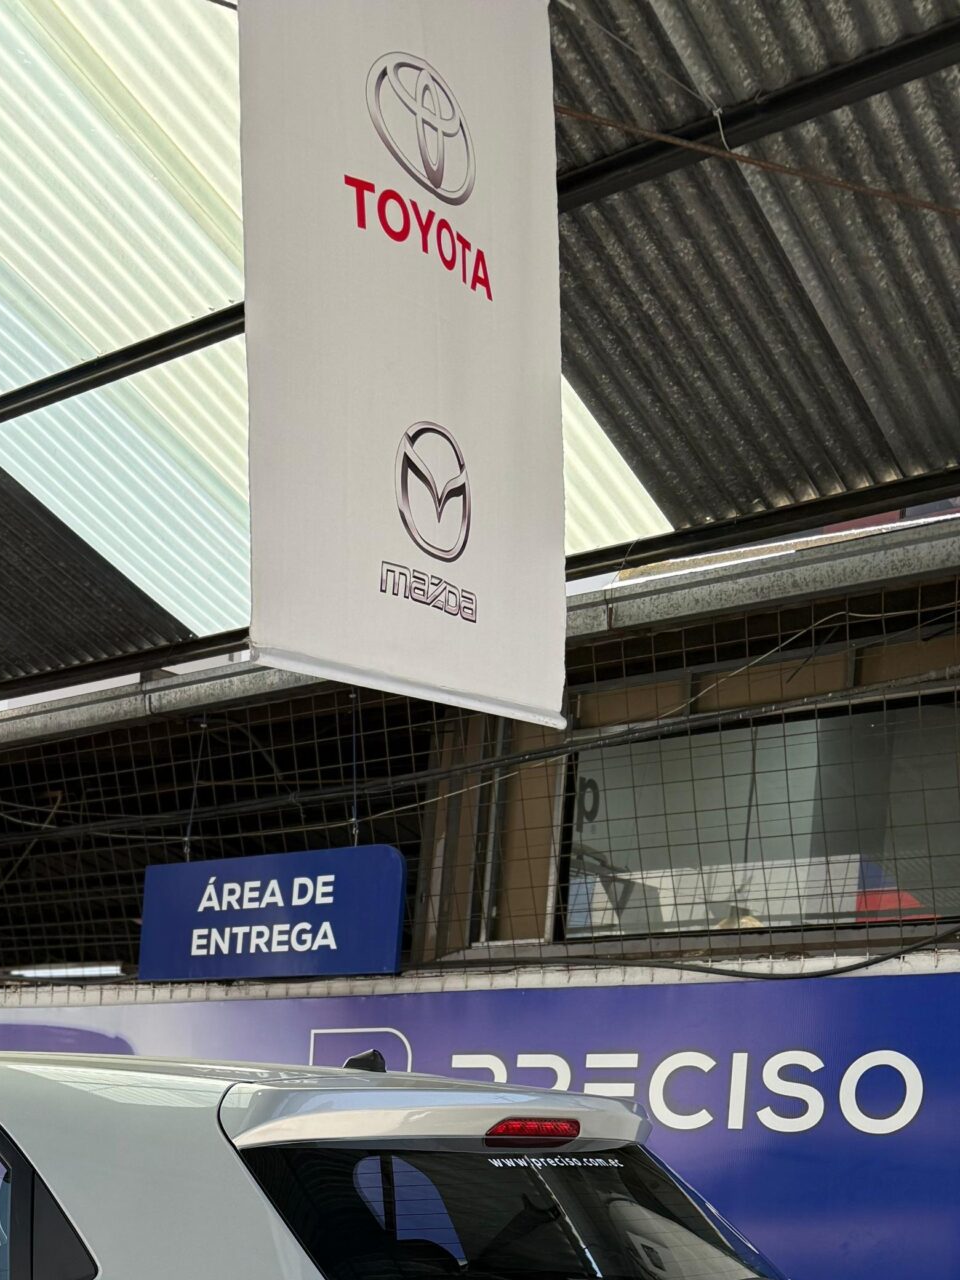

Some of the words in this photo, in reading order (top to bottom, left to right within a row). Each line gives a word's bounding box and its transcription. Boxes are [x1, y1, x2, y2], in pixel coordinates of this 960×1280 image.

[344, 174, 493, 302] TOYOTA
[197, 876, 285, 913] ÁREA
[291, 874, 336, 906] DE
[190, 921, 338, 957] ENTREGA
[488, 1157, 624, 1170] wwwpreciso.com.ec
